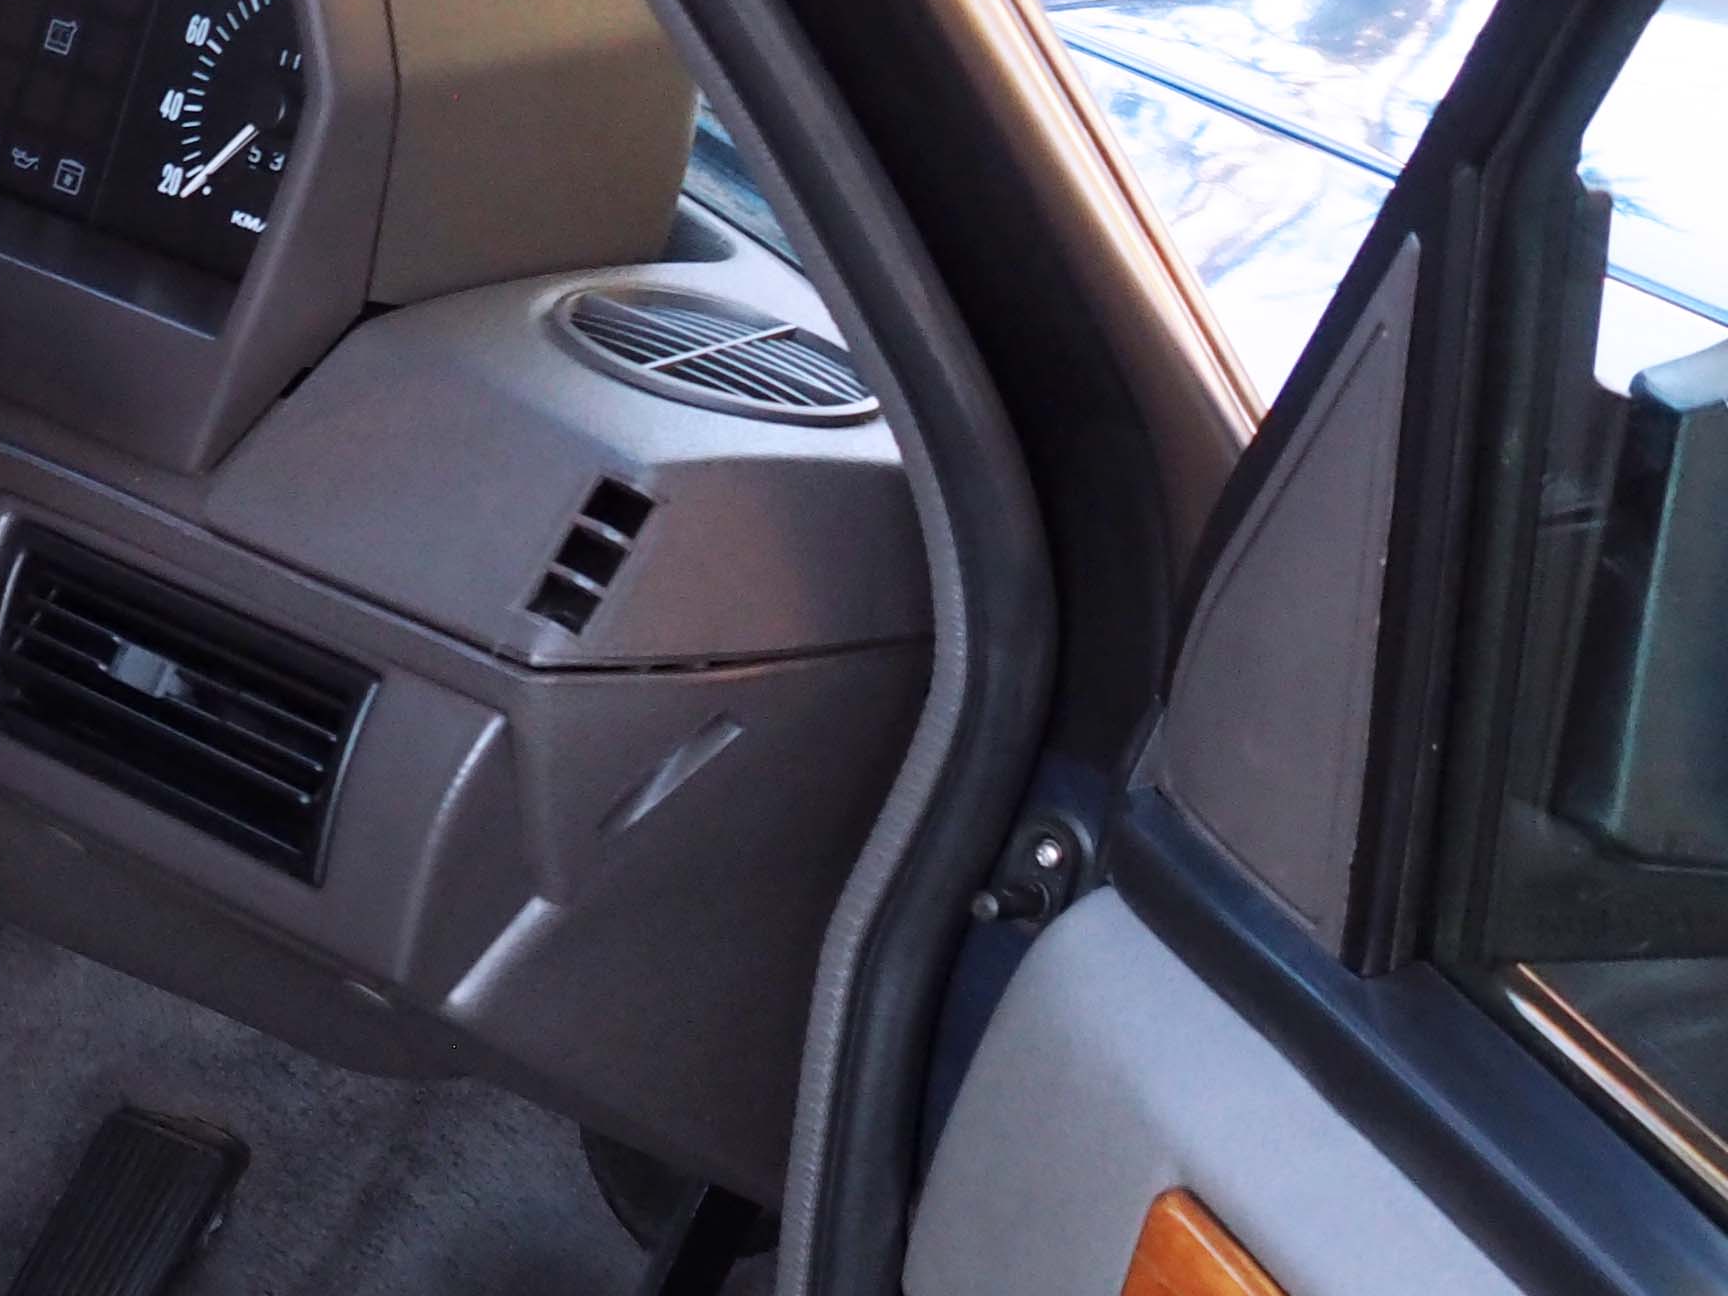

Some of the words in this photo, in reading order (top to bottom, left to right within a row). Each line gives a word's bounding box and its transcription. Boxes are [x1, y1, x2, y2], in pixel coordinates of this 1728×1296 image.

[185, 13, 211, 46] 60
[159, 88, 185, 122] 40
[157, 162, 184, 197] 20
